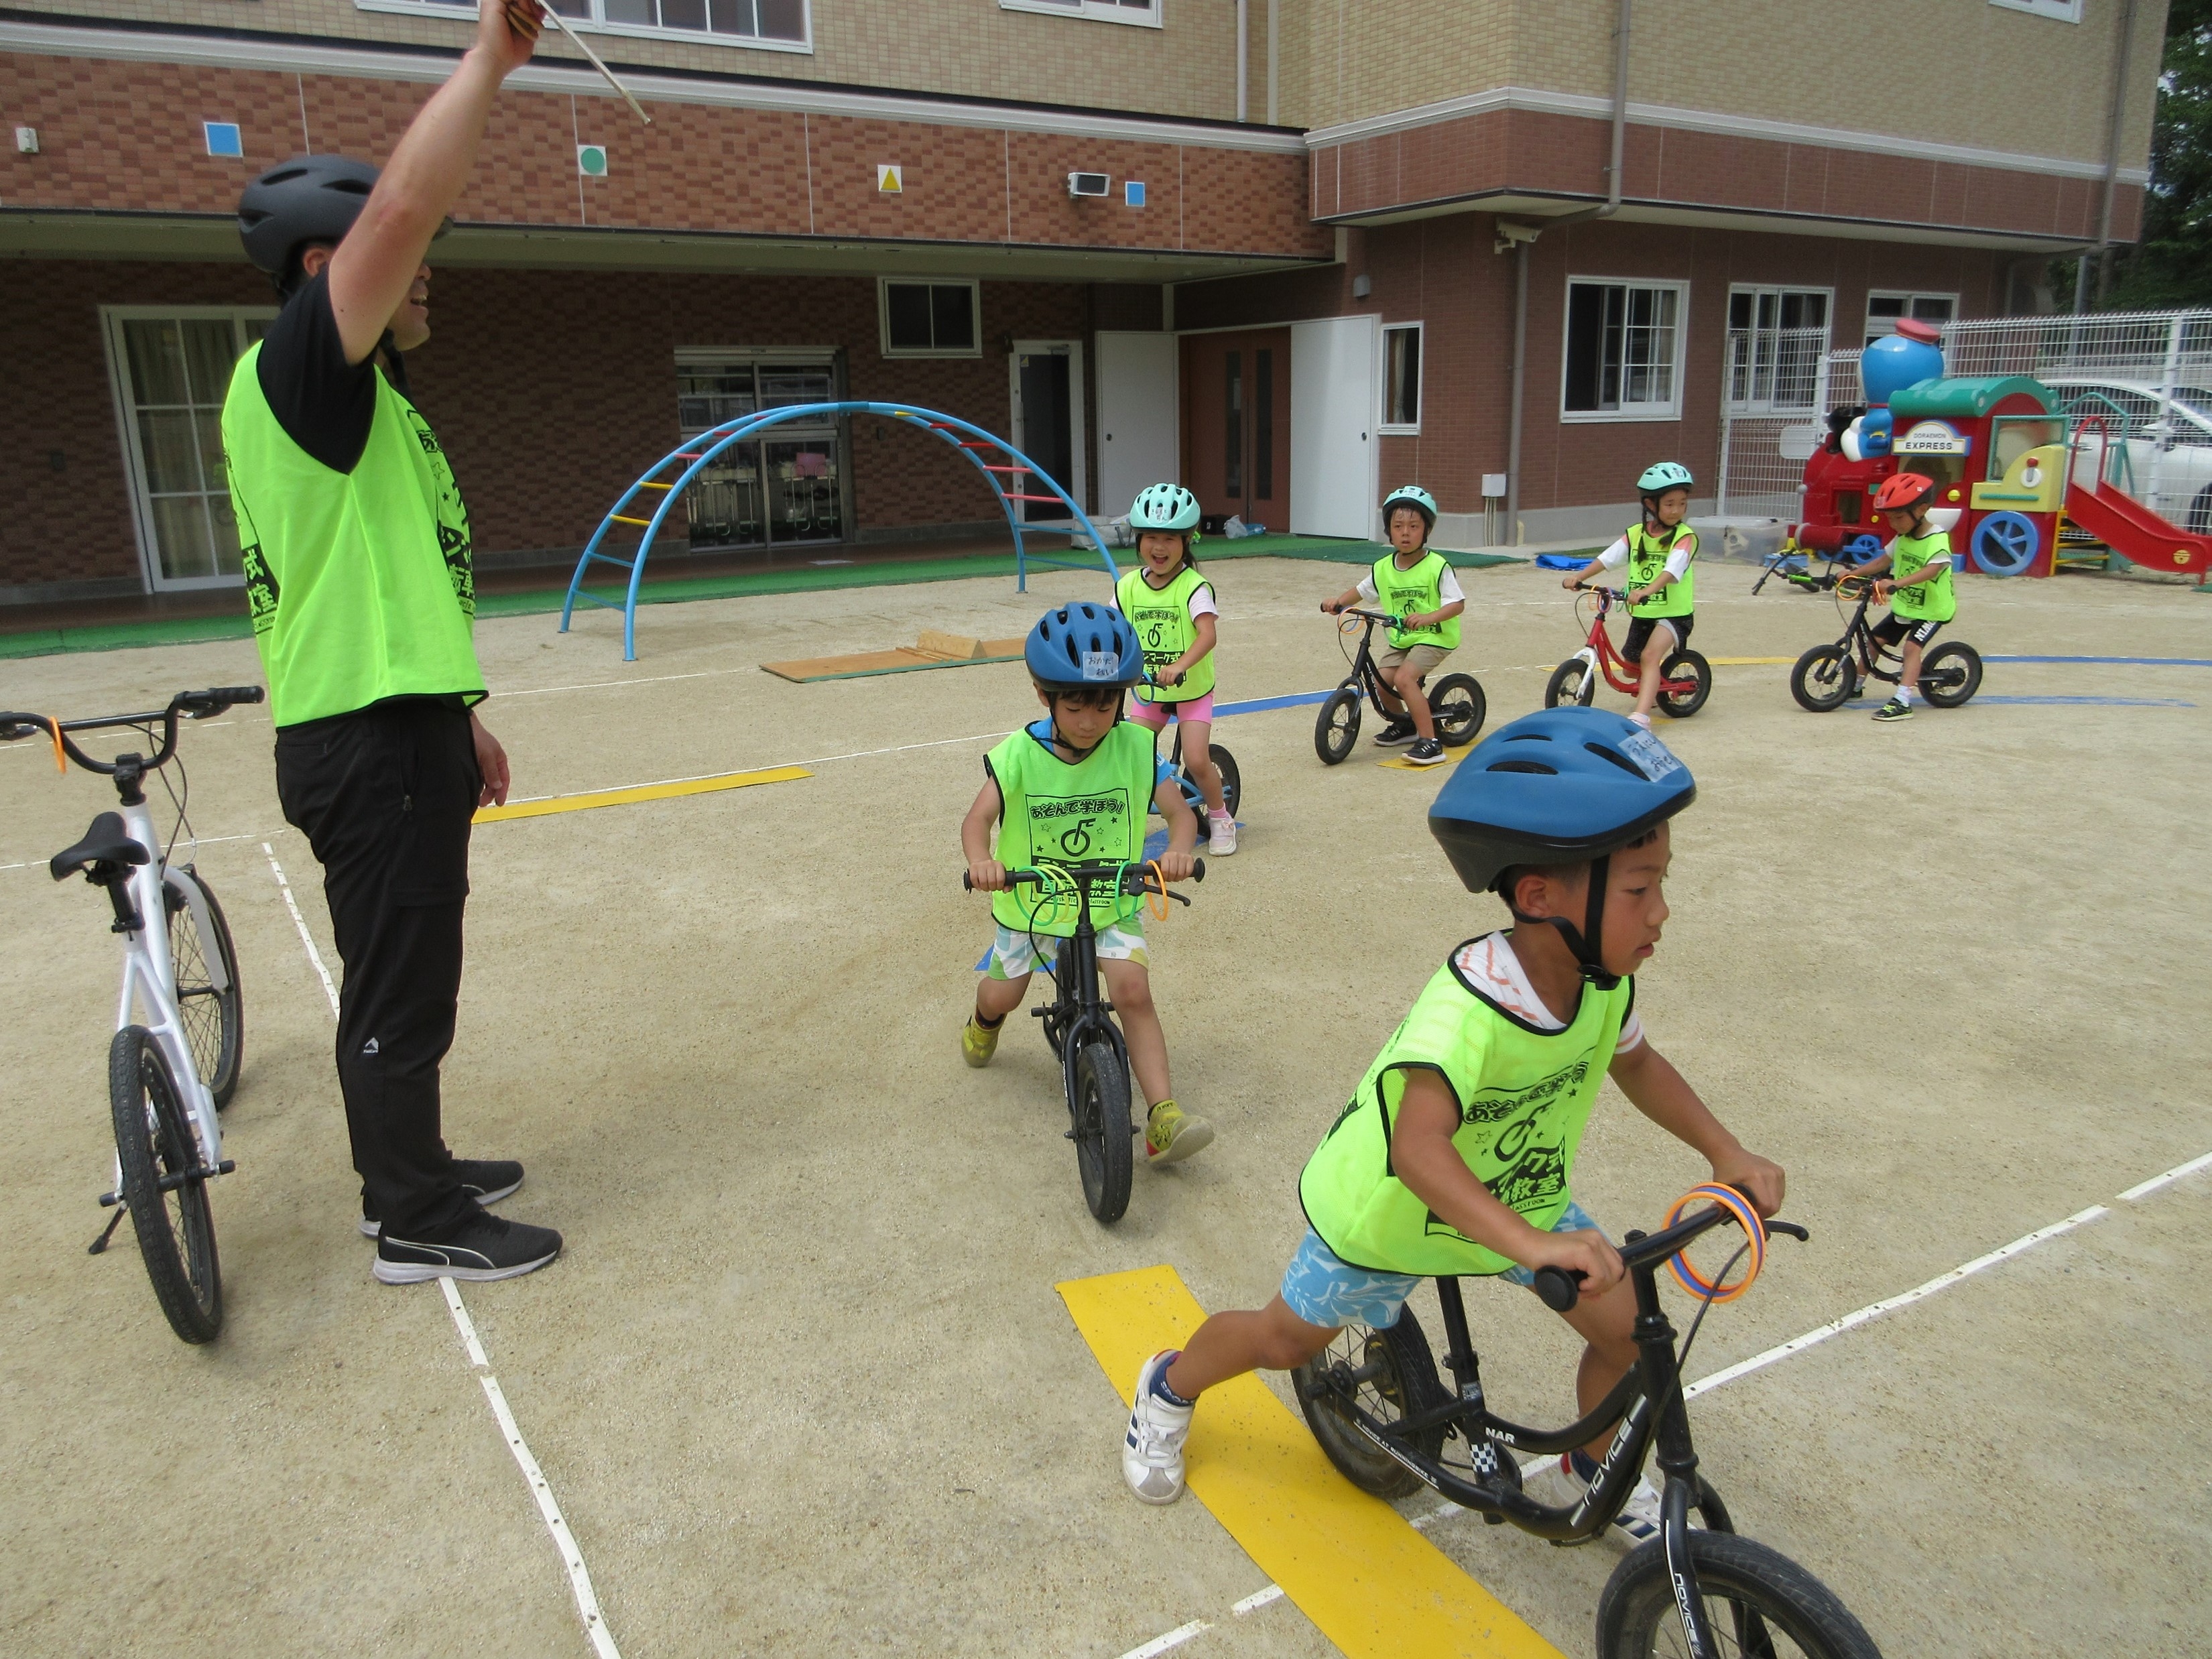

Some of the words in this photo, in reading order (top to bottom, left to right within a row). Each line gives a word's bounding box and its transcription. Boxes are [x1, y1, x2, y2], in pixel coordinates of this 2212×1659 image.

[1905, 442, 1953, 450] EXPRESS
[1030, 798, 1125, 819] あそんで学ぼう!
[1485, 1426, 1516, 1445] NAR
